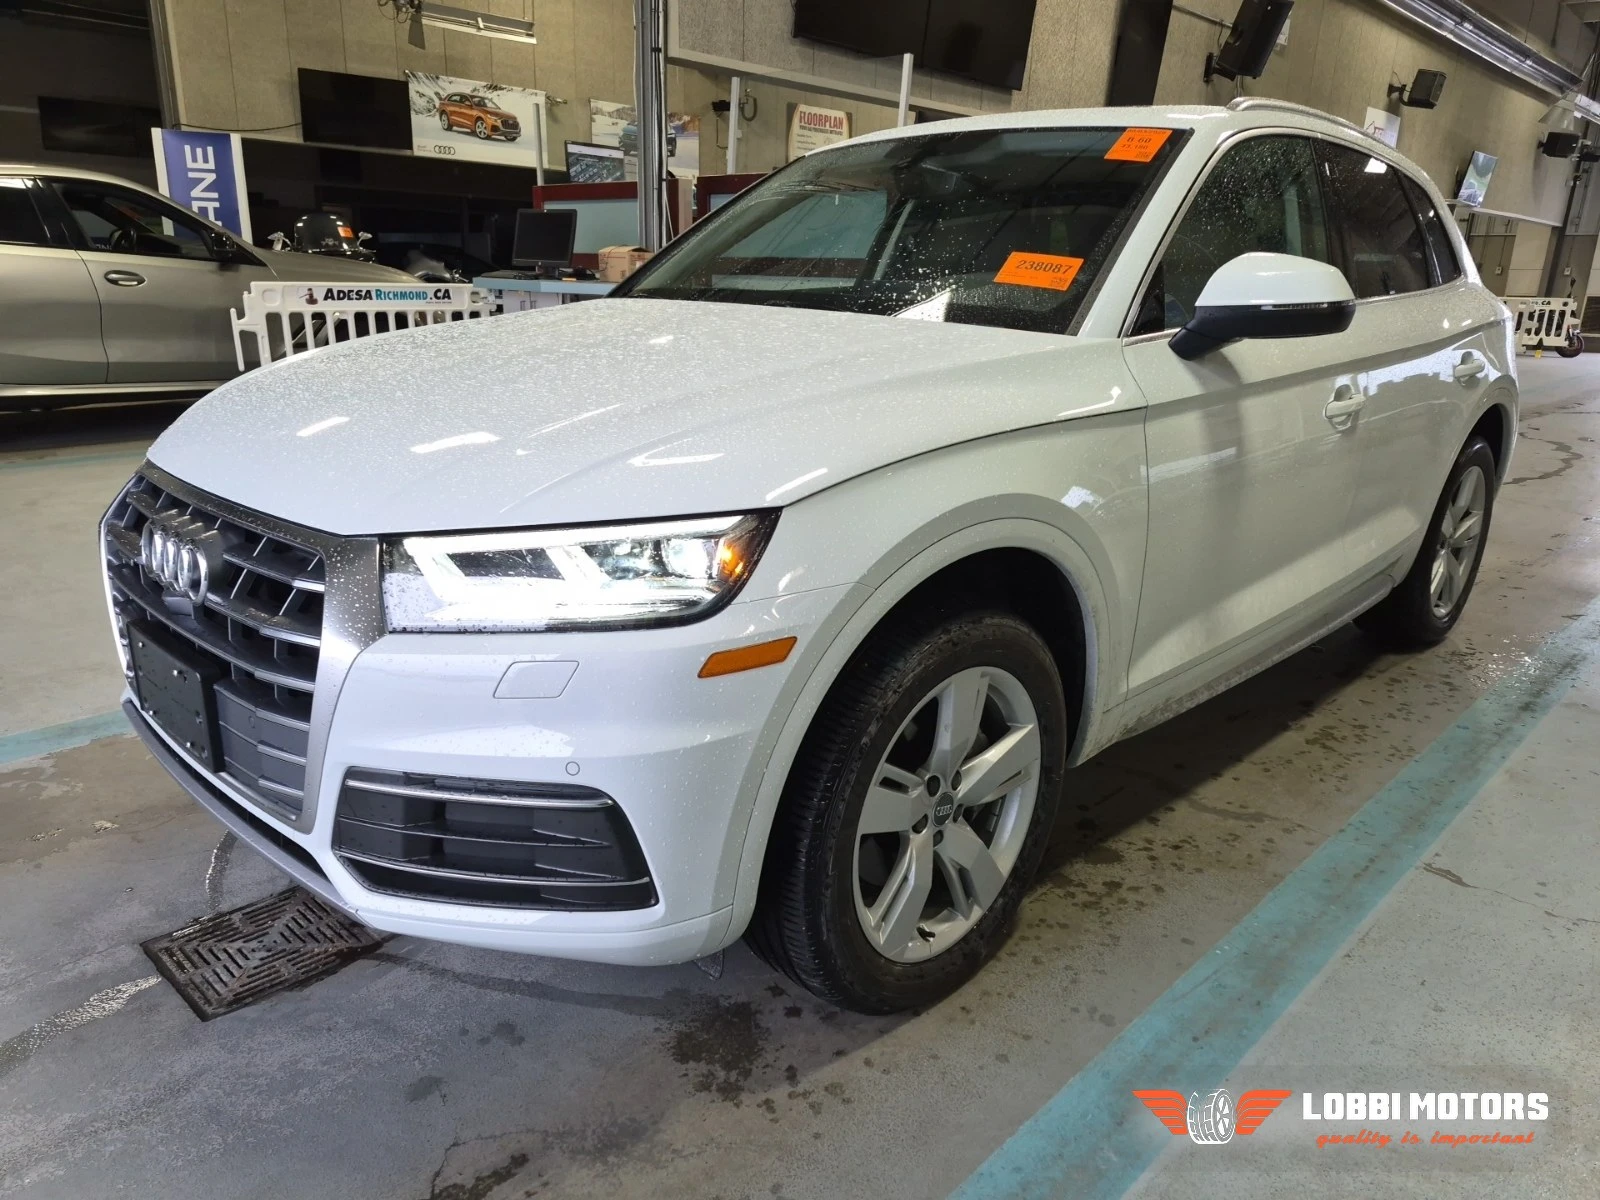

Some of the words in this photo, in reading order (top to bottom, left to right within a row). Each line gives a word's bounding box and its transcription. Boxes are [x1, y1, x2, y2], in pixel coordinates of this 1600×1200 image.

[799, 110, 844, 130] FLOORPLAN
[1016, 259, 1073, 275] 238087
[322, 287, 373, 301] ADESA
